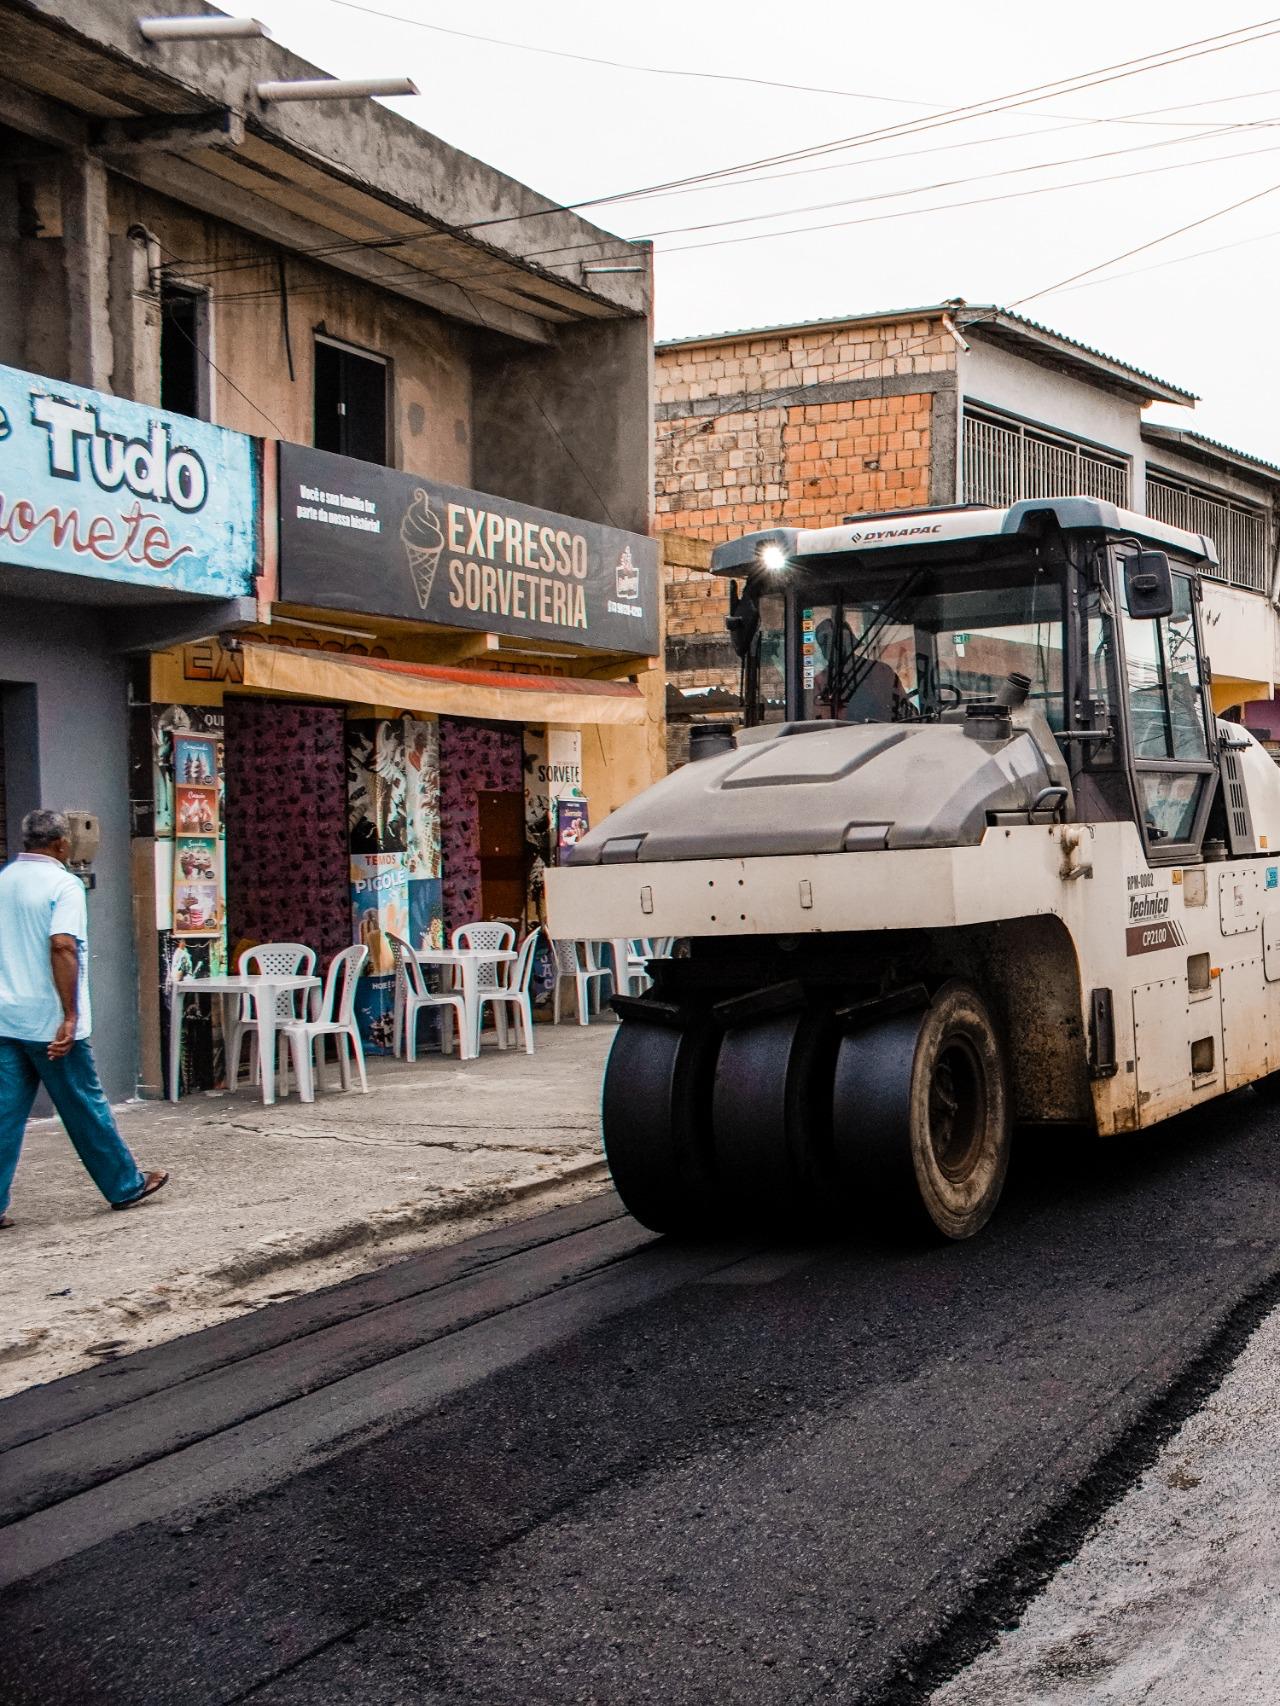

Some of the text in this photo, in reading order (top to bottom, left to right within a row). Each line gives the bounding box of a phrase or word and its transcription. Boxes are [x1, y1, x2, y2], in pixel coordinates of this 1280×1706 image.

[30, 390, 208, 514] Tudo
[447, 502, 588, 579] EXPRESSO
[863, 524, 942, 541] DYNAPAC
[449, 558, 588, 629] SORVETERIA
[538, 765, 580, 783] SORVETE
[365, 854, 397, 866] TEMOS
[1128, 892, 1169, 918] Technico
[1142, 928, 1167, 946] CP2100
